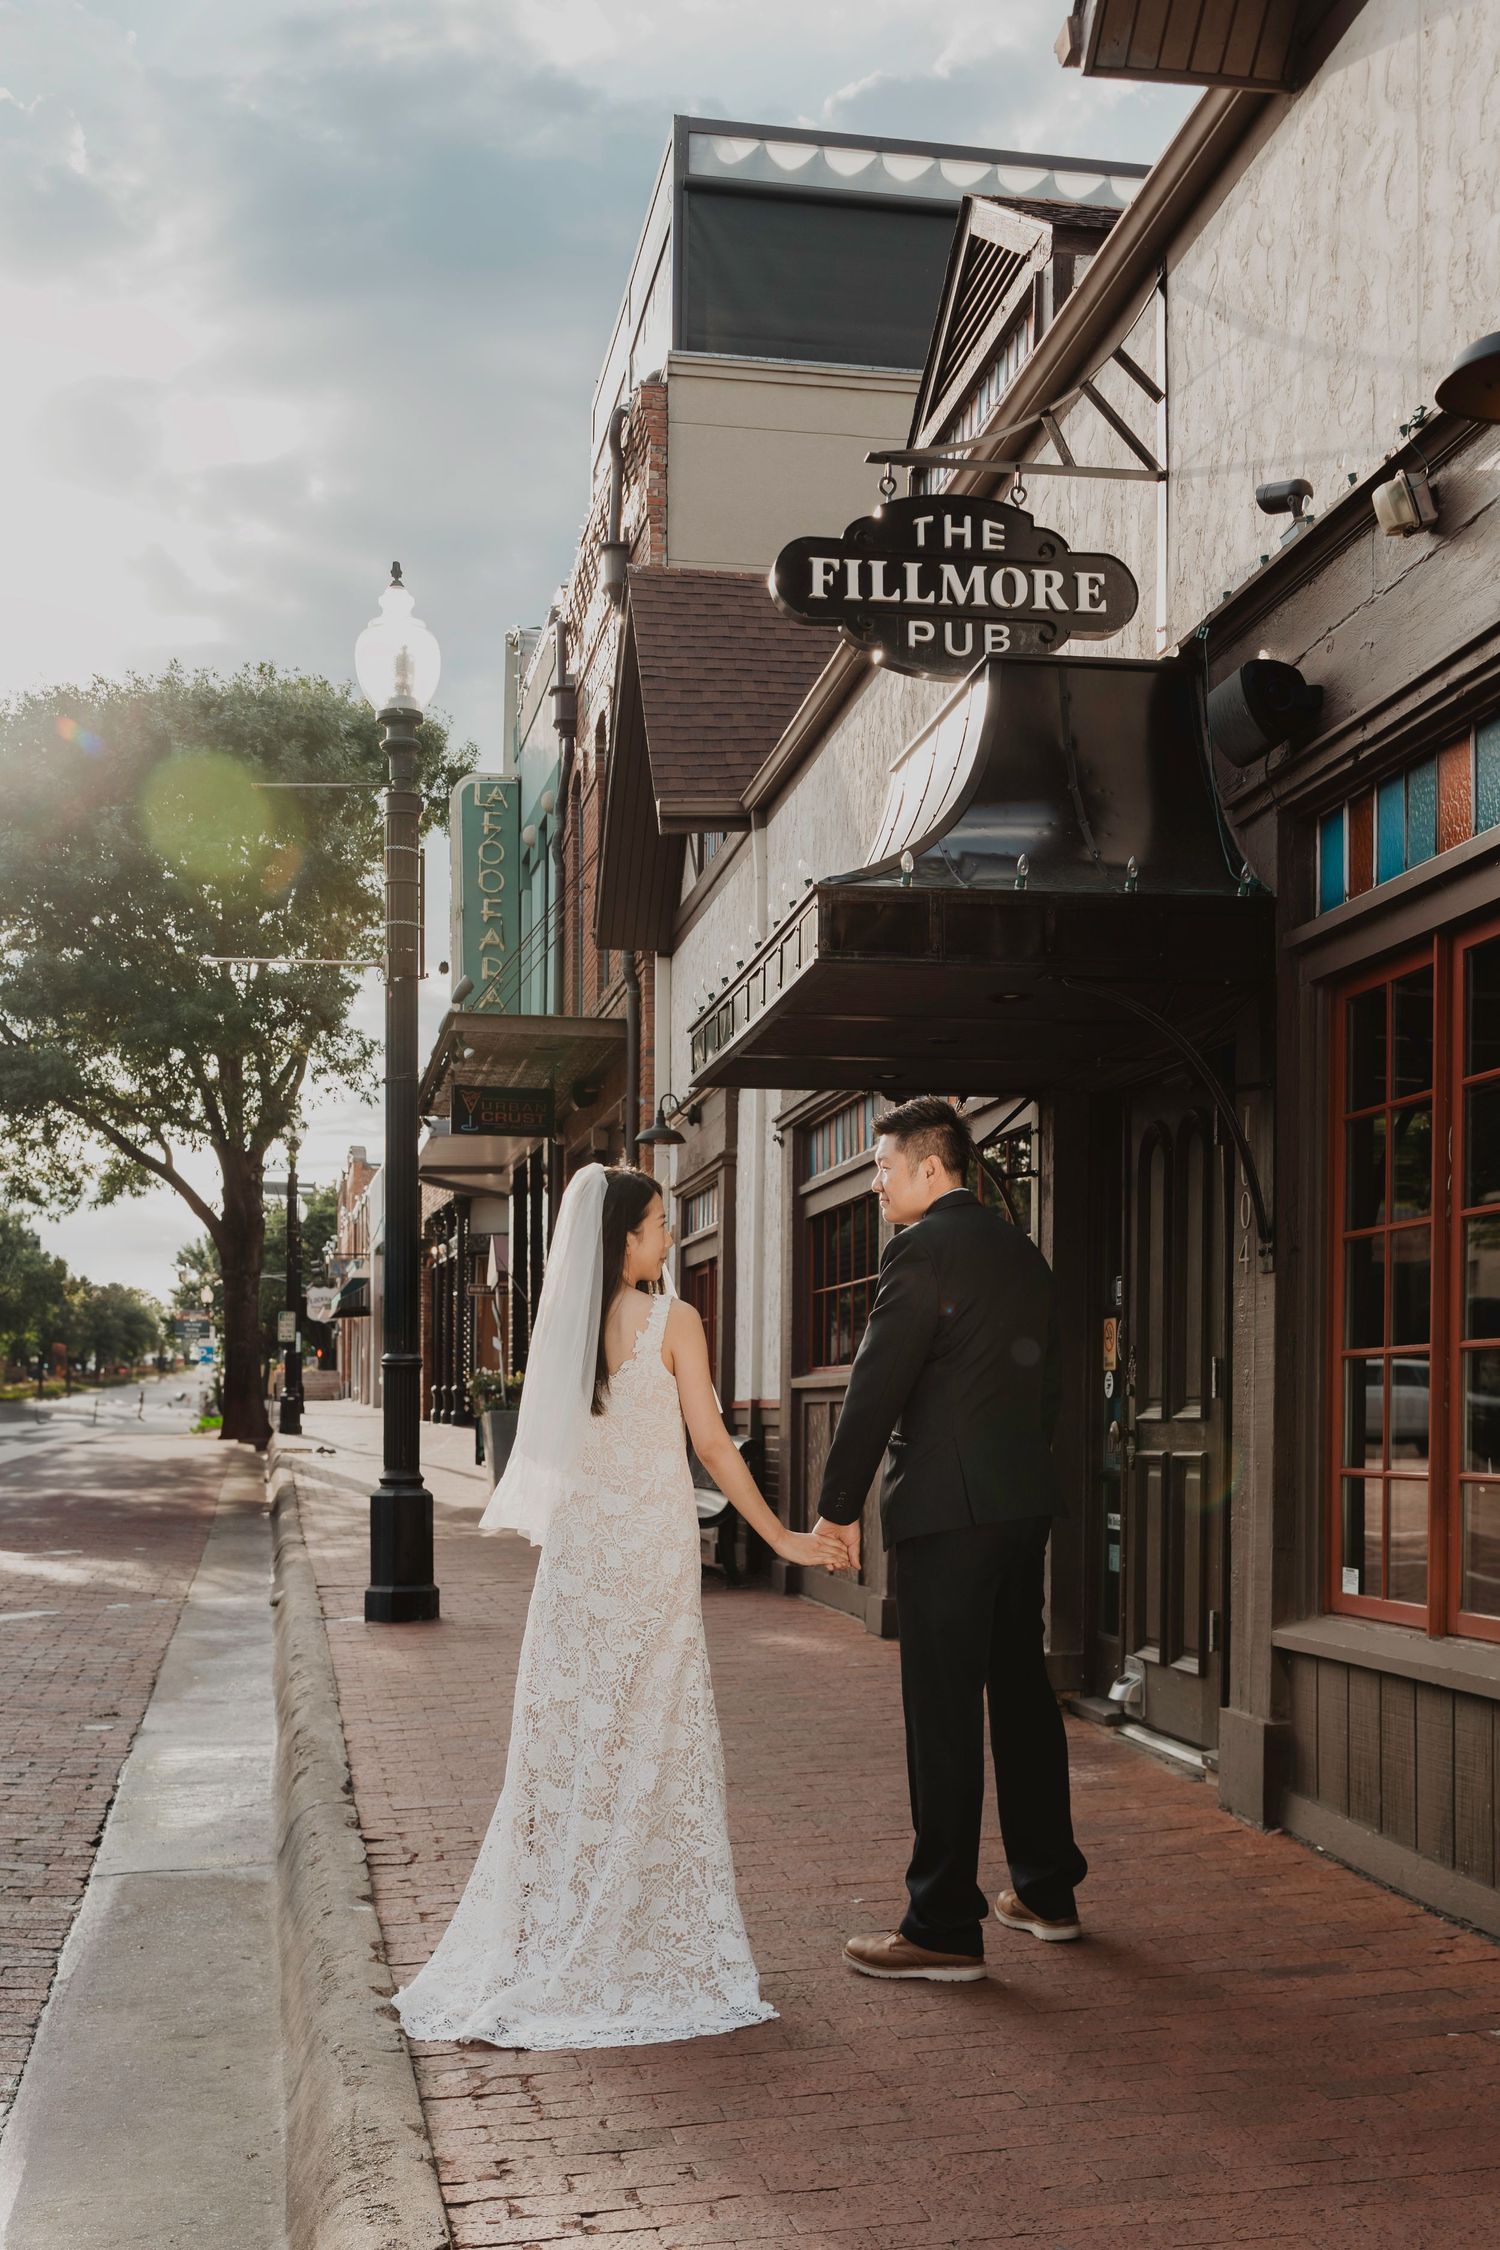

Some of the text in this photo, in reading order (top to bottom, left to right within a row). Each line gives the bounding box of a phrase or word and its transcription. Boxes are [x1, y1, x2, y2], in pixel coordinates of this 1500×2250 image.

[912, 514, 1006, 551] THE
[808, 556, 1107, 614] FILLMORE
[907, 620, 1011, 657] PUB
[474, 783, 509, 808] LA
[481, 1101, 546, 1113] URBAN
[481, 1111, 545, 1124] CRUST
